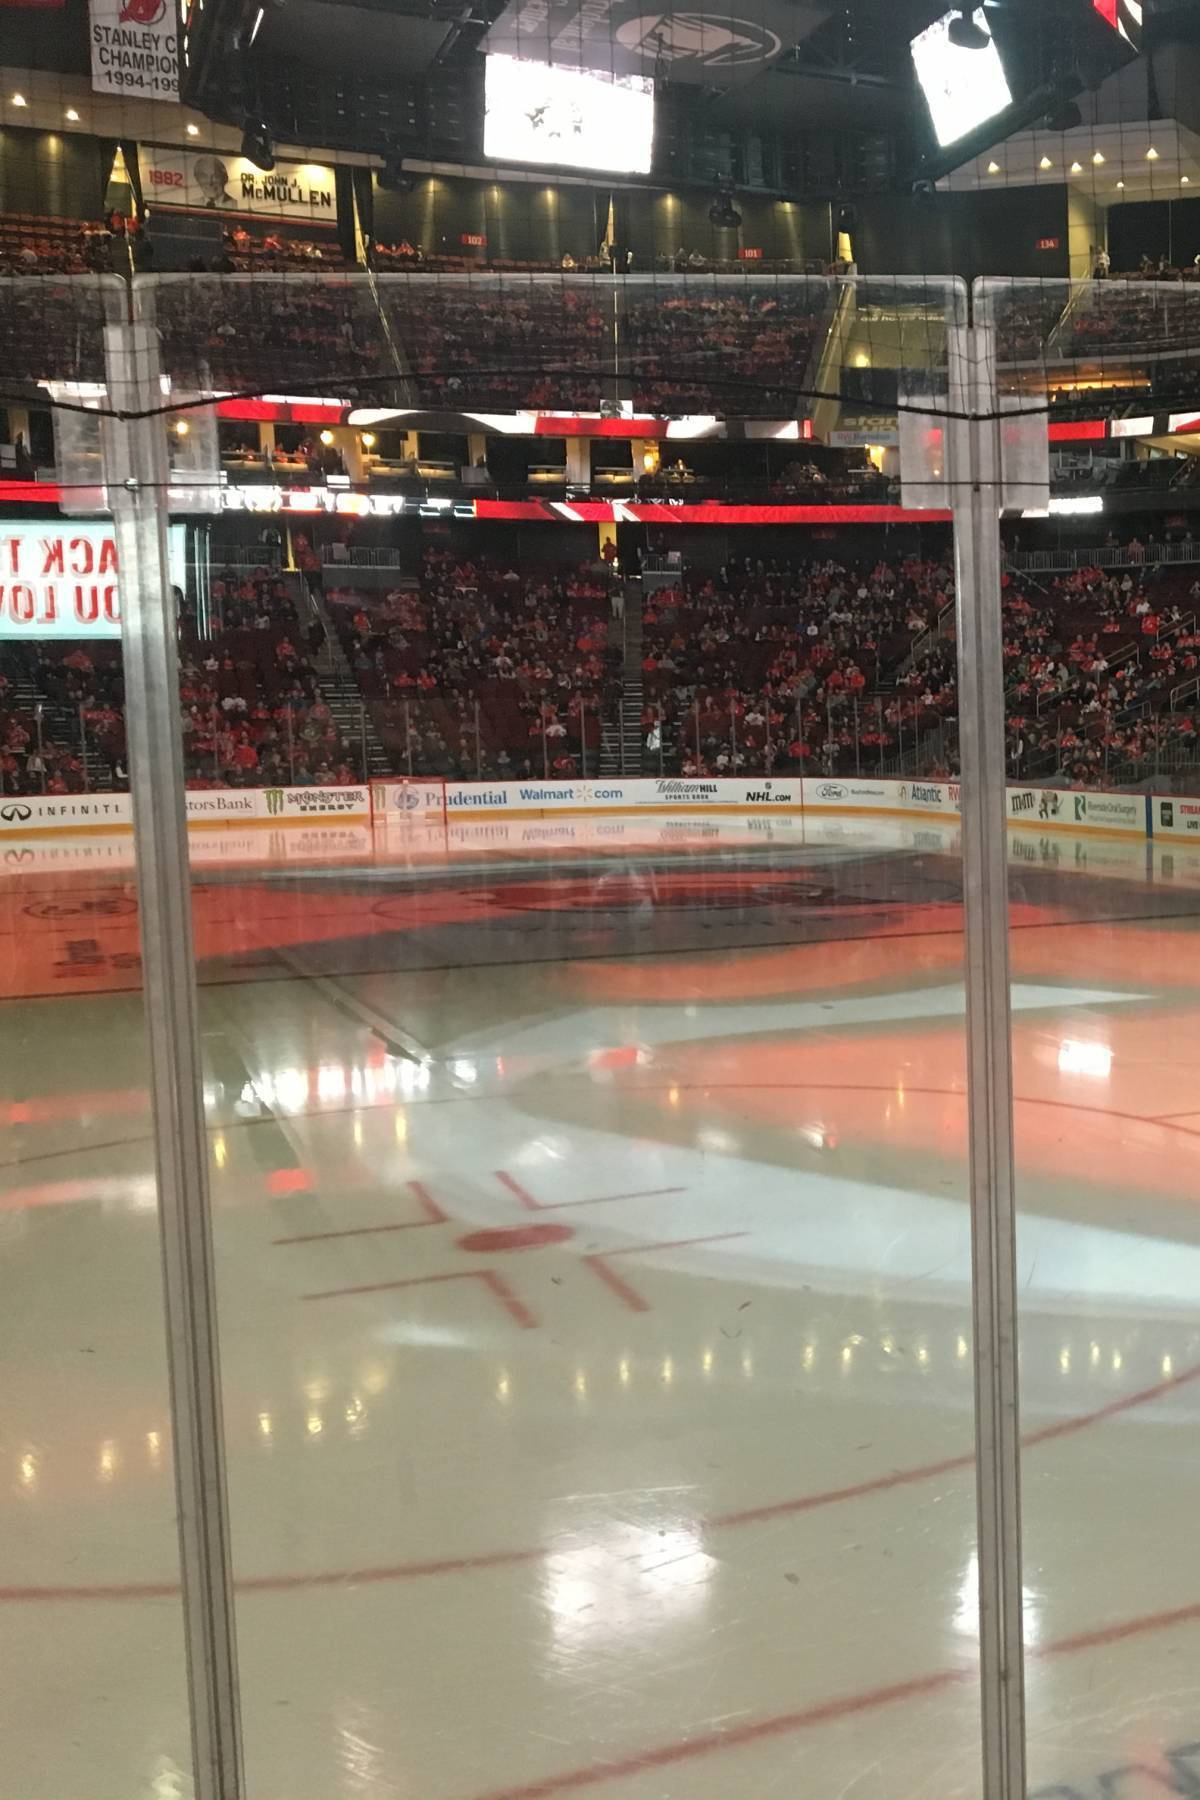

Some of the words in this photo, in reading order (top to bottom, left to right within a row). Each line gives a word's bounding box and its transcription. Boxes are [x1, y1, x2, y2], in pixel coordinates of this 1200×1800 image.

[93, 24, 160, 51] STANLEY
[99, 46, 178, 75] CHAMPION
[104, 69, 179, 93] 1994-199
[149, 170, 183, 187] 1982
[240, 172, 257, 184] DR.
[261, 175, 288, 187] JOHN
[242, 183, 331, 207] McMULLEN
[287, 790, 366, 804] MONSTER
[425, 791, 508, 807] Prudential
[519, 788, 574, 801] Walmart
[185, 797, 253, 813] storsBank
